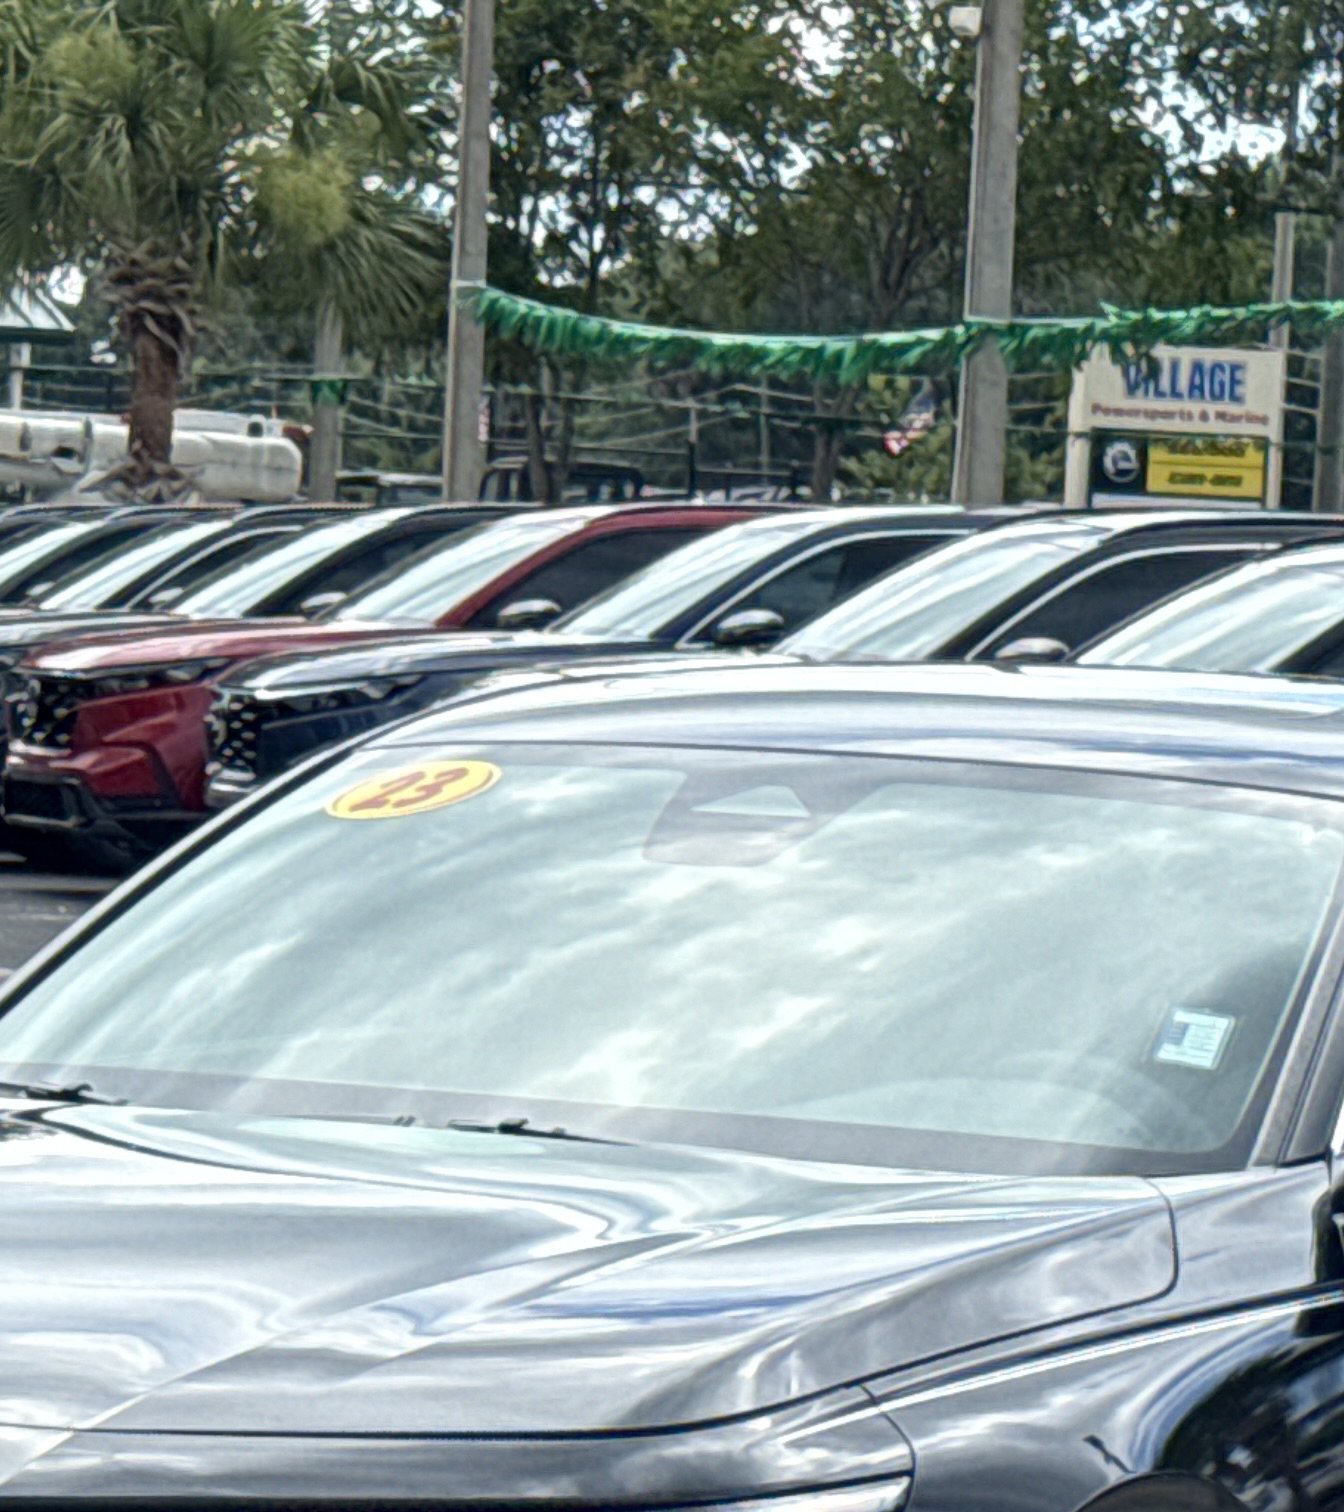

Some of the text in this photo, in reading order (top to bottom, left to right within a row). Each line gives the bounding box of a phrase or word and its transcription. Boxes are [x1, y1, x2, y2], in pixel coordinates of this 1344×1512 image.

[1122, 357, 1247, 403] VILLAGE
[1091, 402, 1195, 422] Powersports
[1214, 409, 1270, 426] Marine
[348, 766, 470, 813] 23
